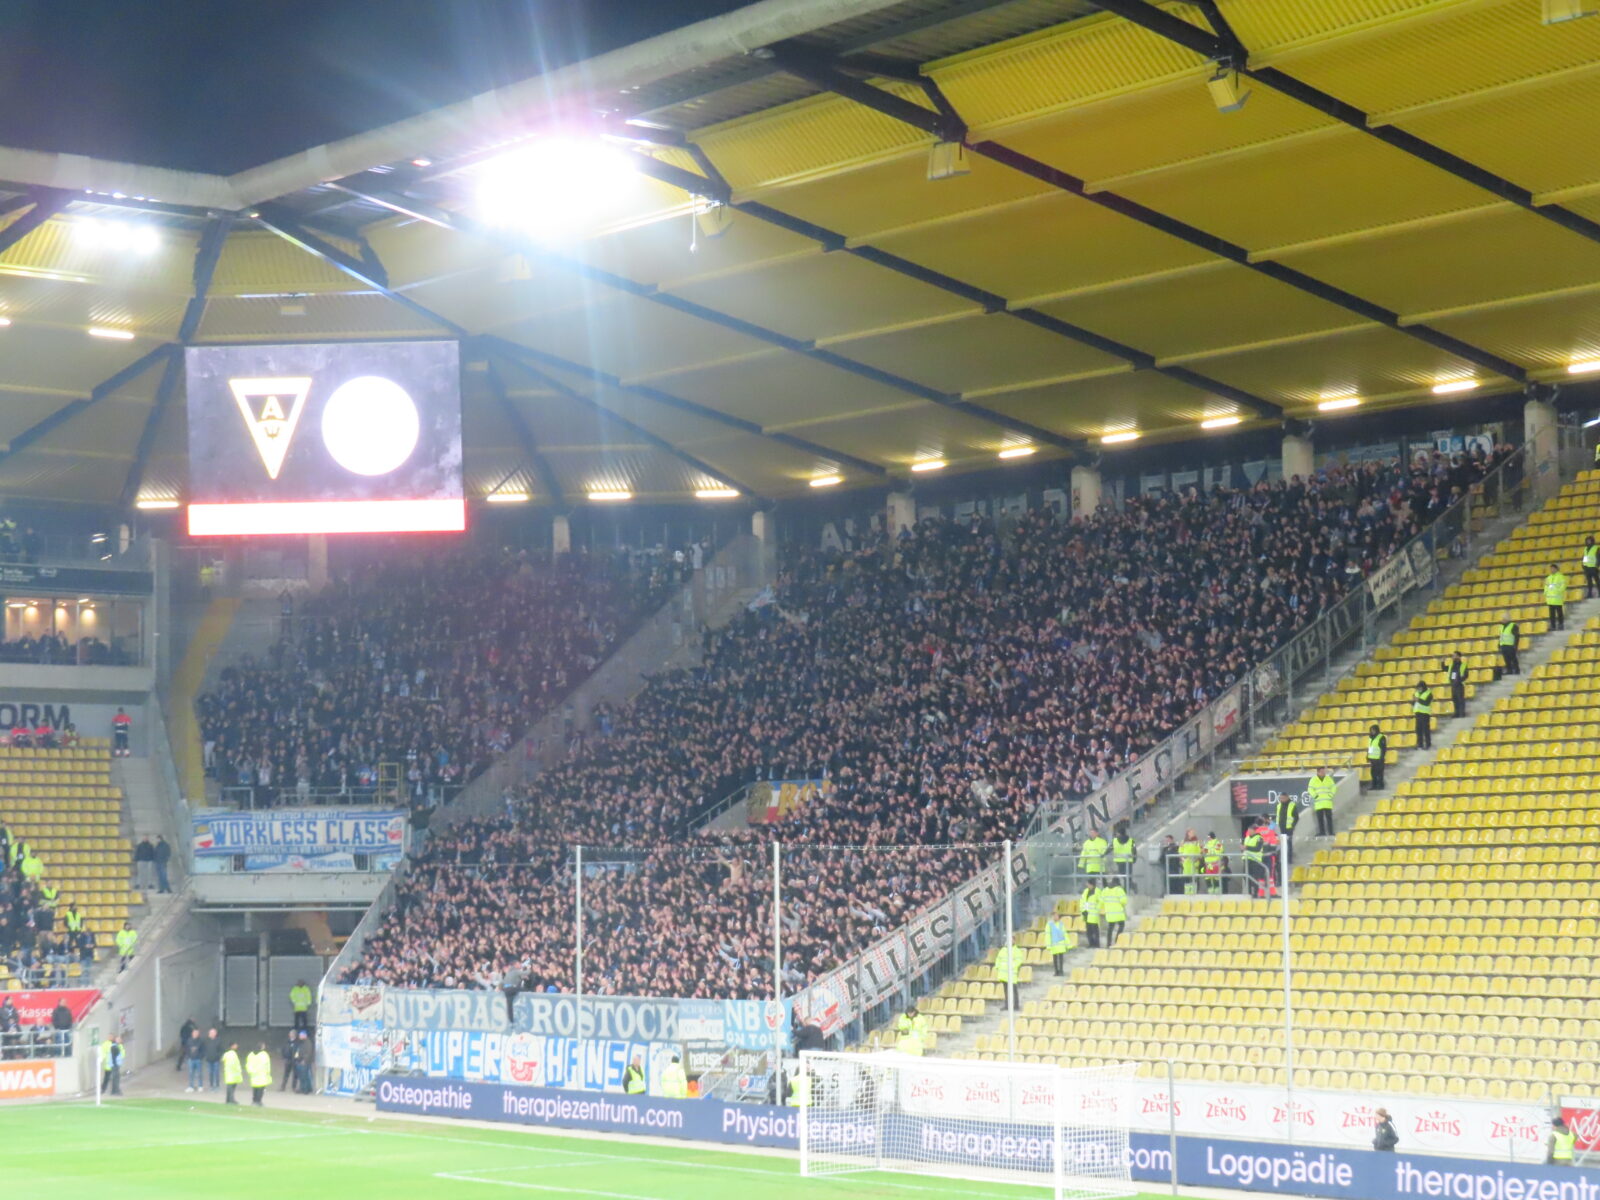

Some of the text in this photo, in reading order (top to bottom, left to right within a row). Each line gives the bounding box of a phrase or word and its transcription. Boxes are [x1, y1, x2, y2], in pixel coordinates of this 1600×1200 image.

[210, 820, 388, 846] WORKLESS CLASS
[844, 911, 956, 1012] ALLES
[18, 1005, 54, 1017] rkasse
[384, 991, 507, 1032] SUPTRAS
[530, 998, 679, 1040] ROSTOCK
[725, 1000, 761, 1031] NB
[726, 1032, 746, 1046] ON
[750, 1033, 788, 1047] TOUR
[380, 1081, 472, 1111] Osteopathie
[911, 1082, 944, 1101] ZENTIS
[966, 1086, 1000, 1104] ZENTIS
[1022, 1088, 1055, 1106] ZENTI
[503, 1090, 683, 1128] therapiezentrum.com
[1142, 1098, 1181, 1117] ZENTS
[1206, 1101, 1247, 1122] ZENTIS
[1341, 1111, 1379, 1129] ZENT
[1414, 1115, 1461, 1138] ZENTIS
[922, 1122, 1173, 1171] therapiezenrum.com
[1207, 1145, 1354, 1187] Logopädie
